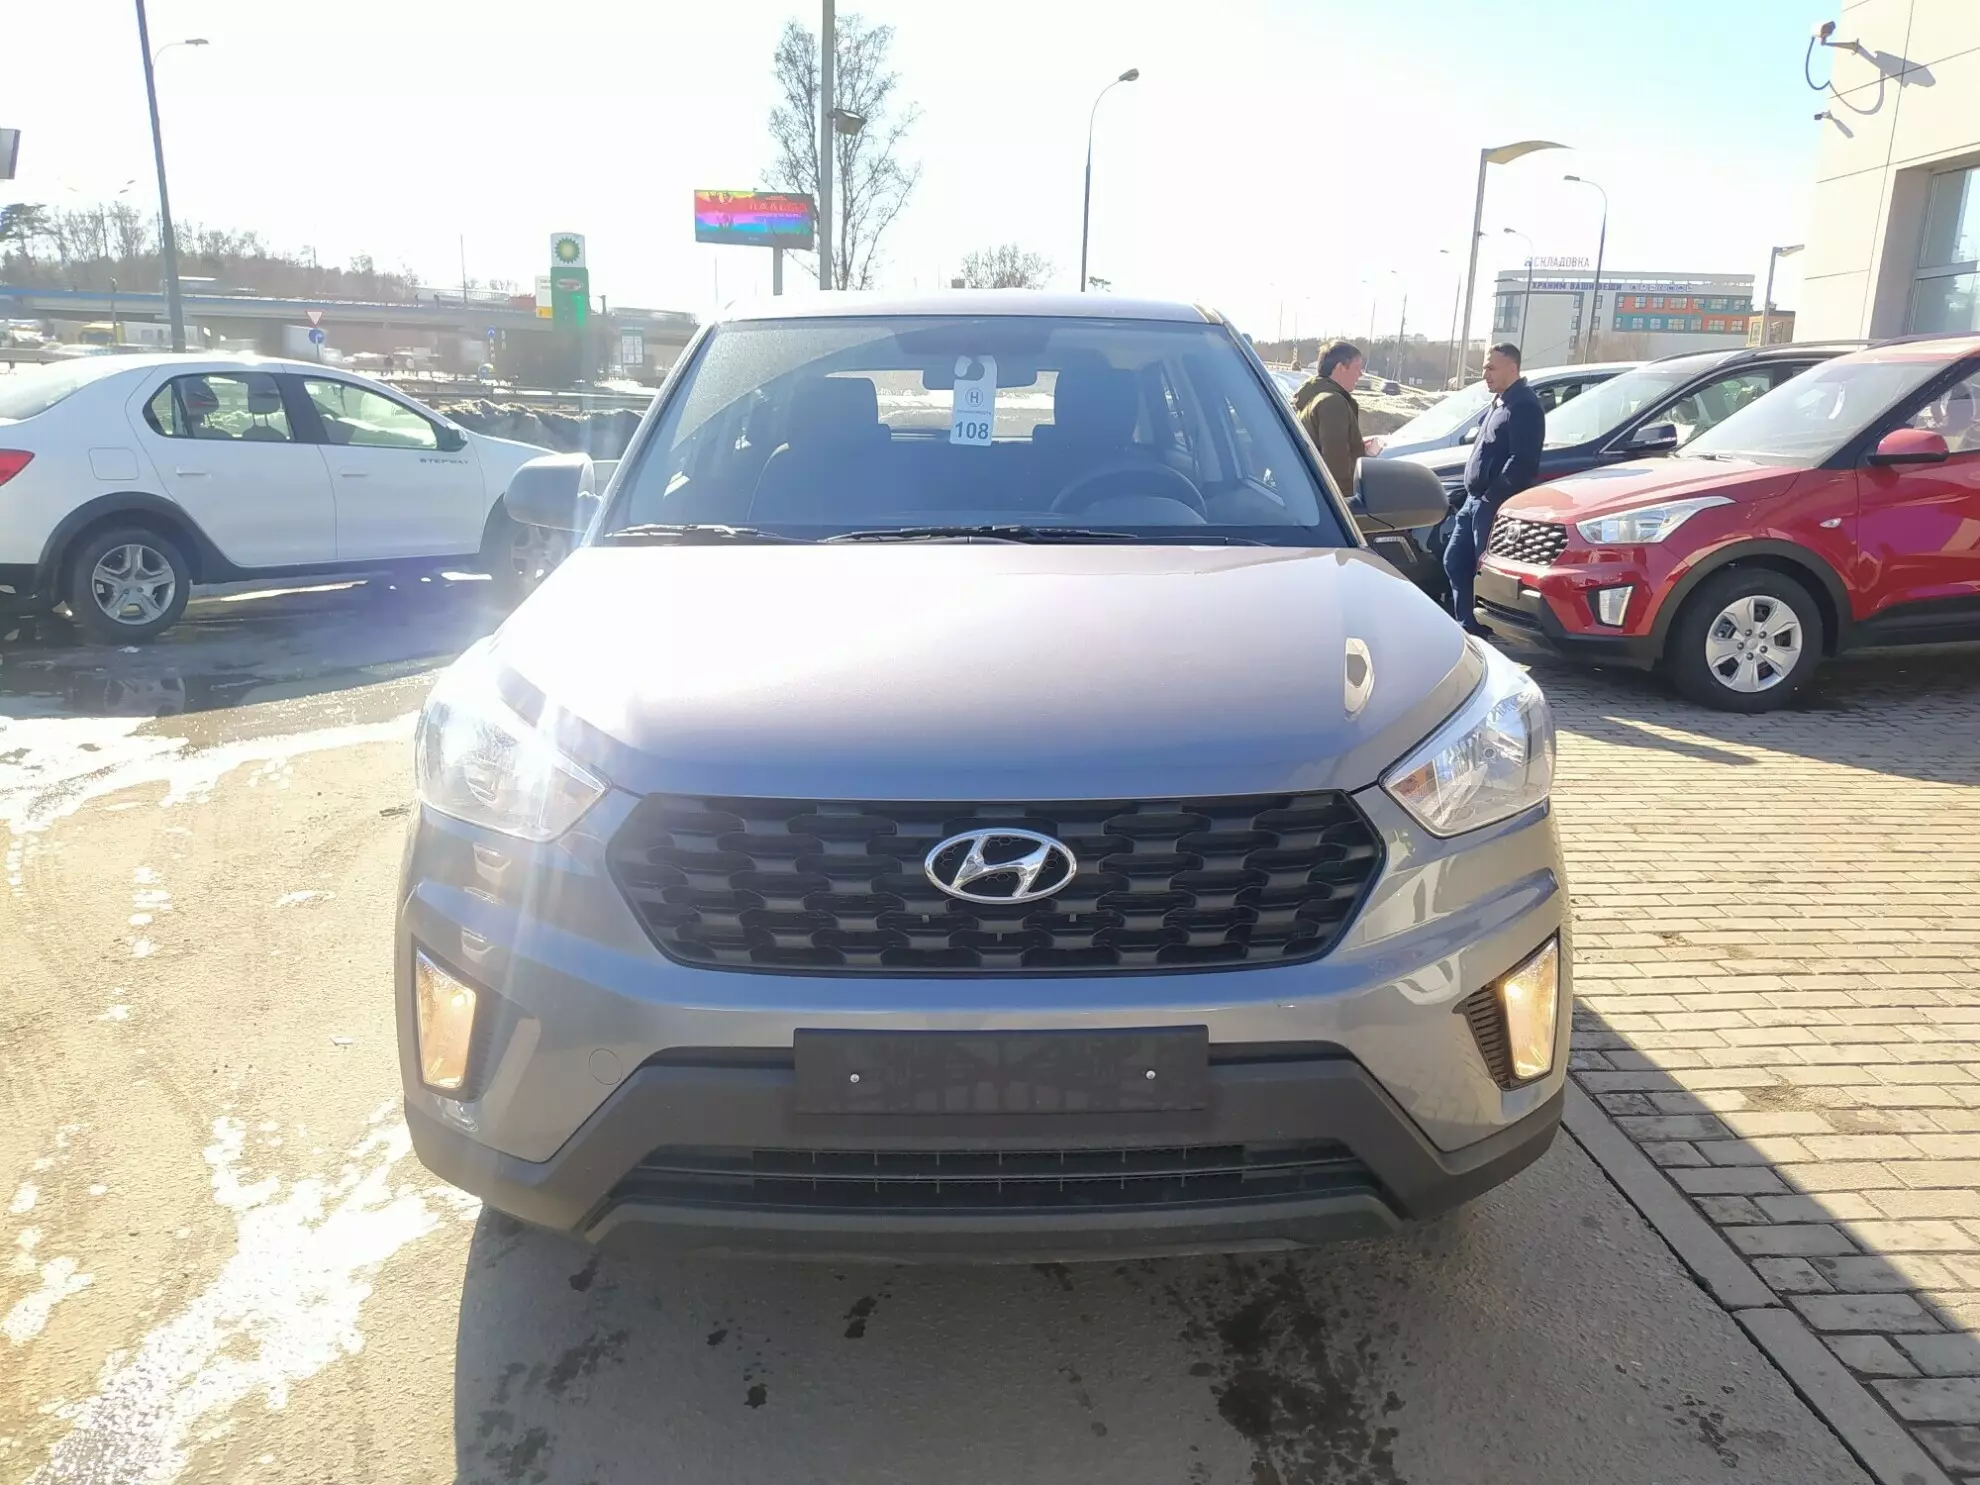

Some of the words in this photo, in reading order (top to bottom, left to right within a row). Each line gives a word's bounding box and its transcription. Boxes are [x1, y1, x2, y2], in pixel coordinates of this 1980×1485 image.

[1533, 256, 1590, 268] СКЛАДОВКА
[1532, 282, 1566, 290] ХРАНИМ
[1570, 282, 1594, 291] ВАШИ
[955, 420, 989, 440] 108
